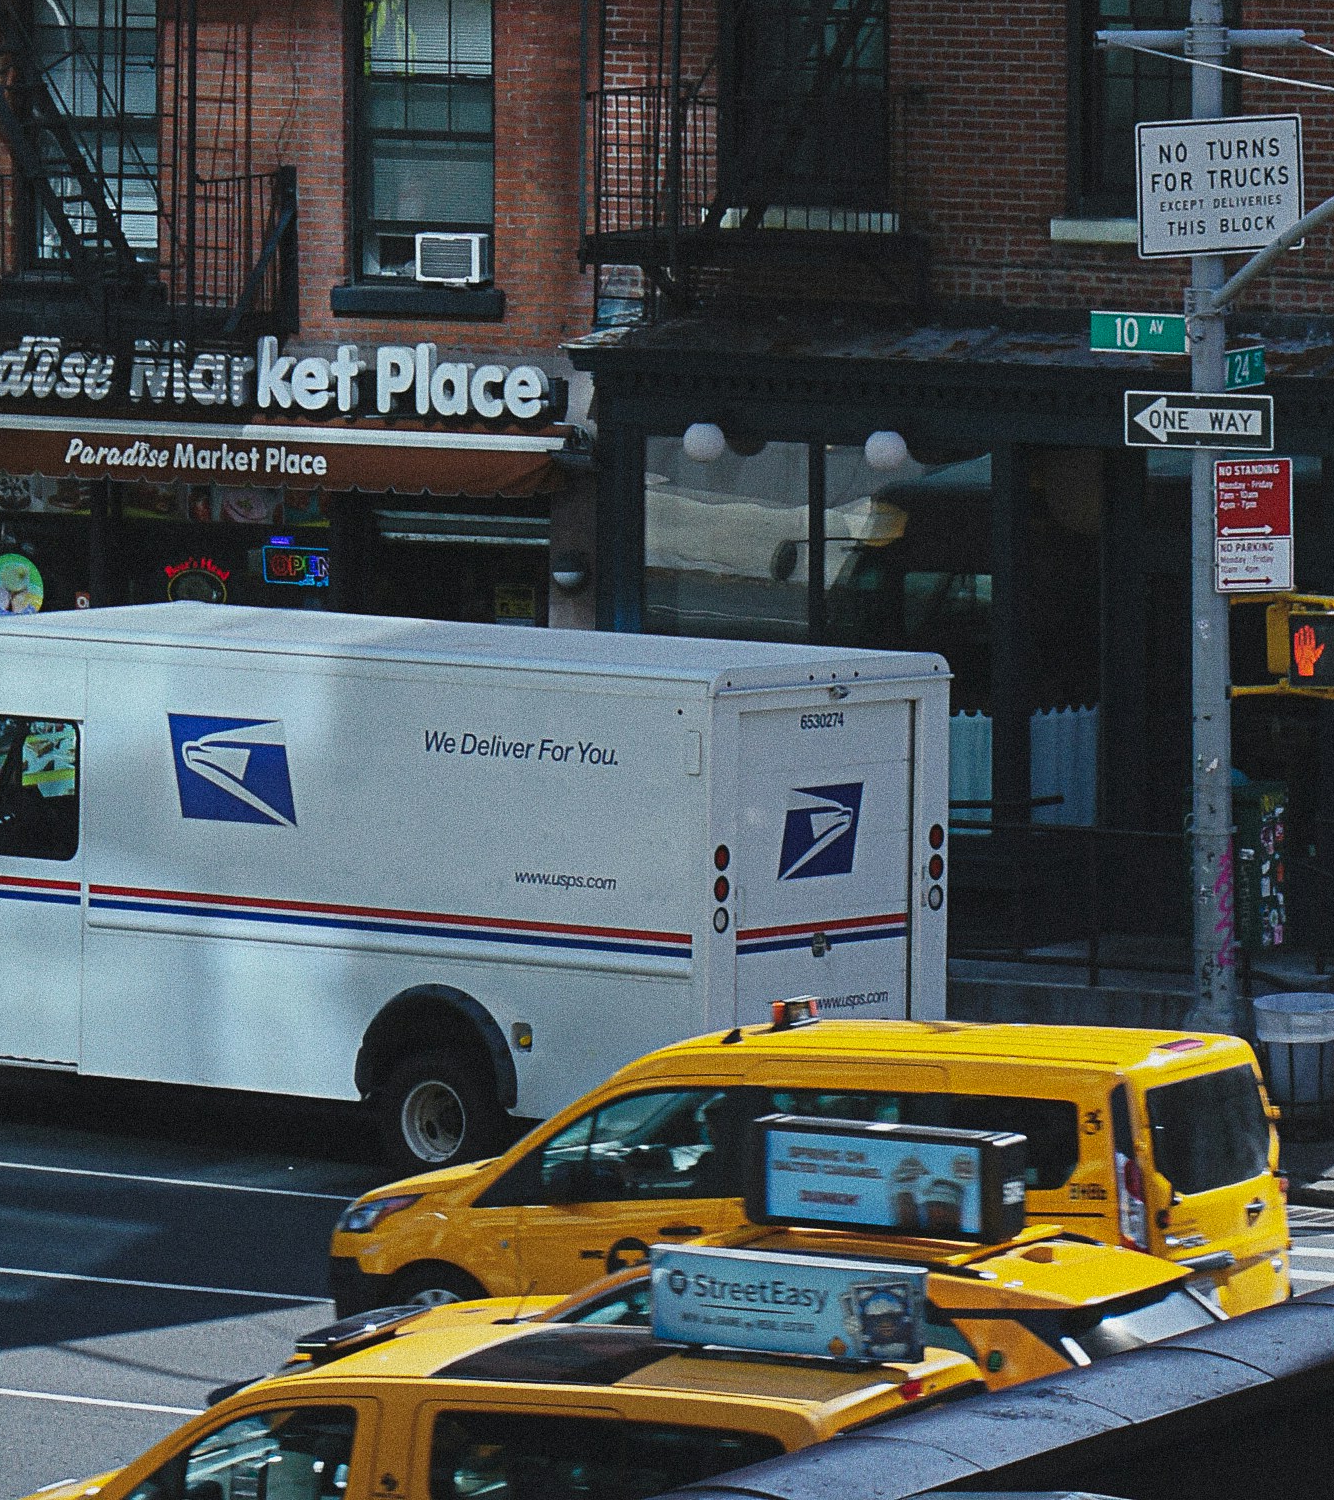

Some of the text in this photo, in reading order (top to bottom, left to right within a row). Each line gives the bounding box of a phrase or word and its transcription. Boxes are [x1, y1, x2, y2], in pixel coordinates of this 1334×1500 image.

[1159, 138, 1280, 164] NO TURNS
[1151, 166, 1289, 193] FOR TRUCKS
[1160, 194, 1282, 212] EXCEPT DELIVERIES
[1168, 216, 1276, 236] THIS BLOCK
[1115, 317, 1165, 347] 10 AV
[130, 336, 363, 412] Market
[376, 342, 548, 419] Place
[1235, 355, 1250, 384] 24
[1149, 410, 1253, 432] ONE WAY
[65, 438, 327, 475] Paradise Market Place
[1219, 464, 1280, 476] NO STANDING
[1236, 542, 1274, 552] PARKING
[270, 554, 330, 577] OPEN
[800, 711, 844, 729] 6530274
[424, 729, 619, 766] We Deliver For You.
[515, 870, 617, 890] www.usps.com
[694, 1273, 829, 1314] StreetEasy
